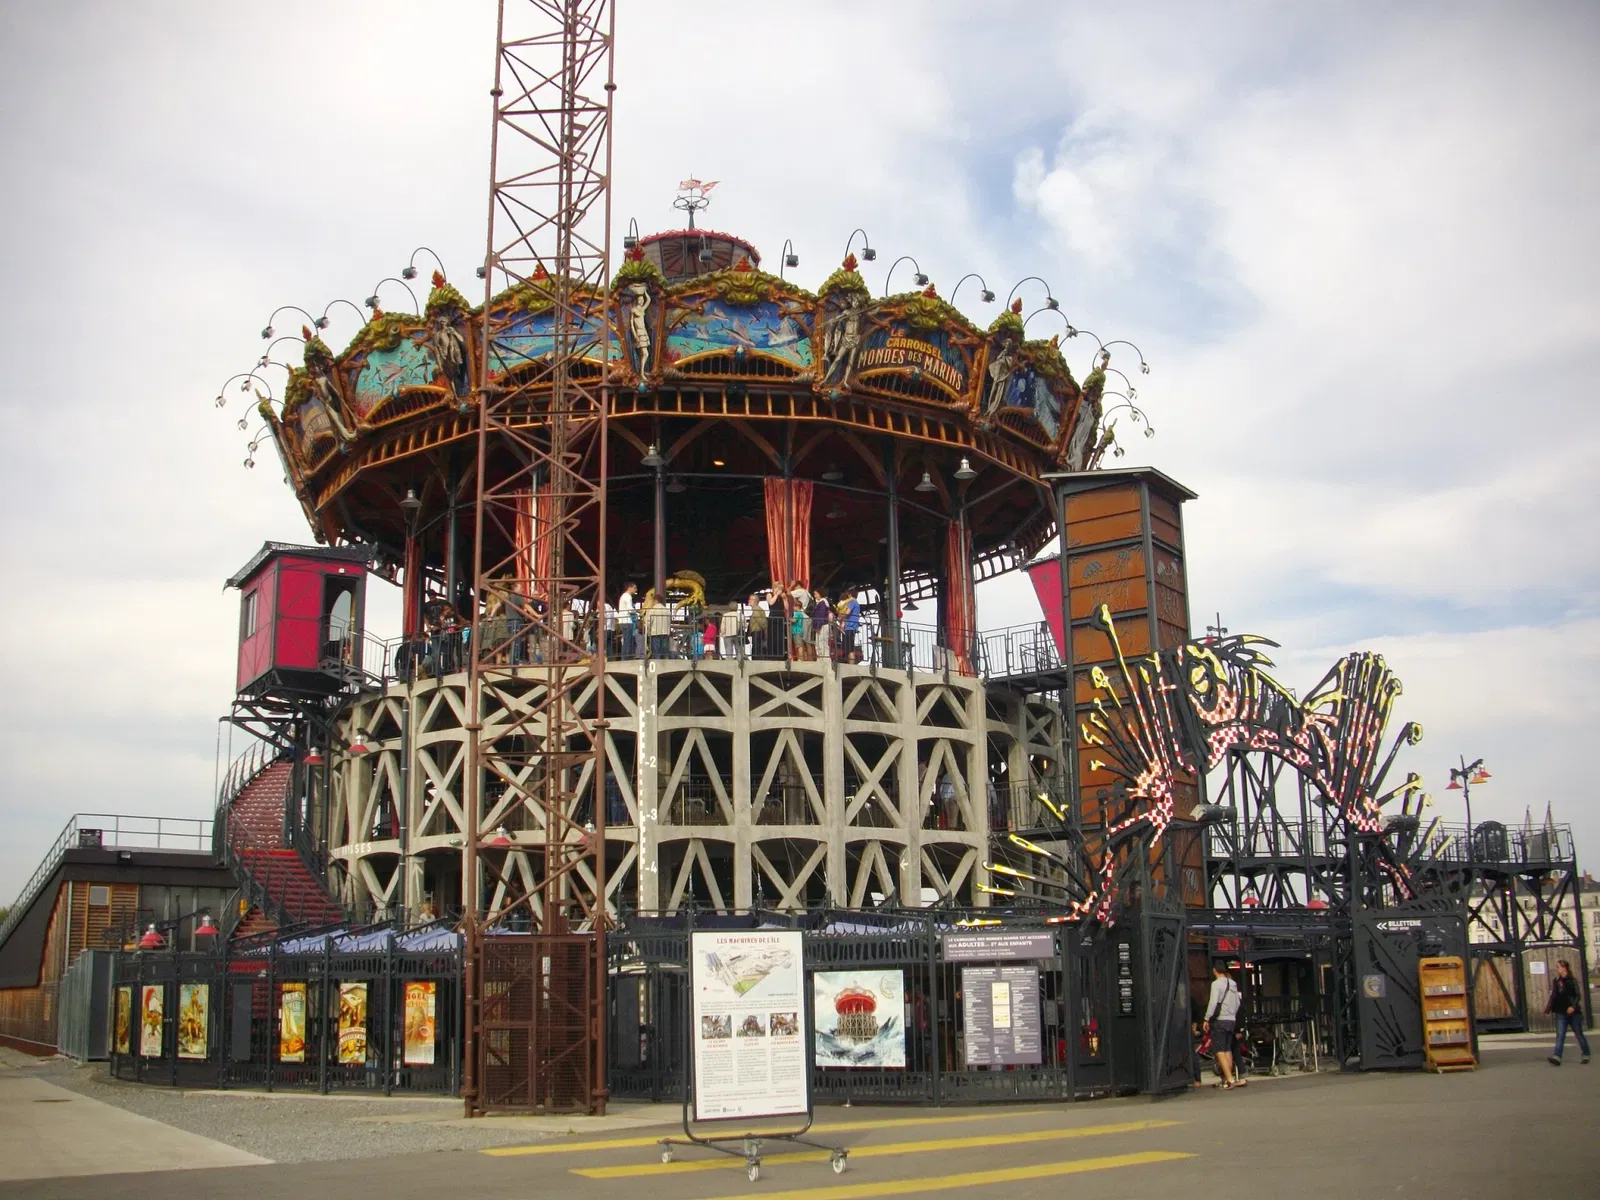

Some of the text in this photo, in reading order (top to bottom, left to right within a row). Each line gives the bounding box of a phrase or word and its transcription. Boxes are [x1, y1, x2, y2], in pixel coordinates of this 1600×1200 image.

[890, 328, 905, 337] LE
[886, 338, 943, 360] CARROUSEL
[858, 348, 963, 391] MONDES DES MARINS
[649, 661, 656, 673] 0
[645, 704, 656, 716] -1
[644, 756, 657, 768] -2
[645, 808, 658, 820] -3
[644, 861, 657, 874] -4
